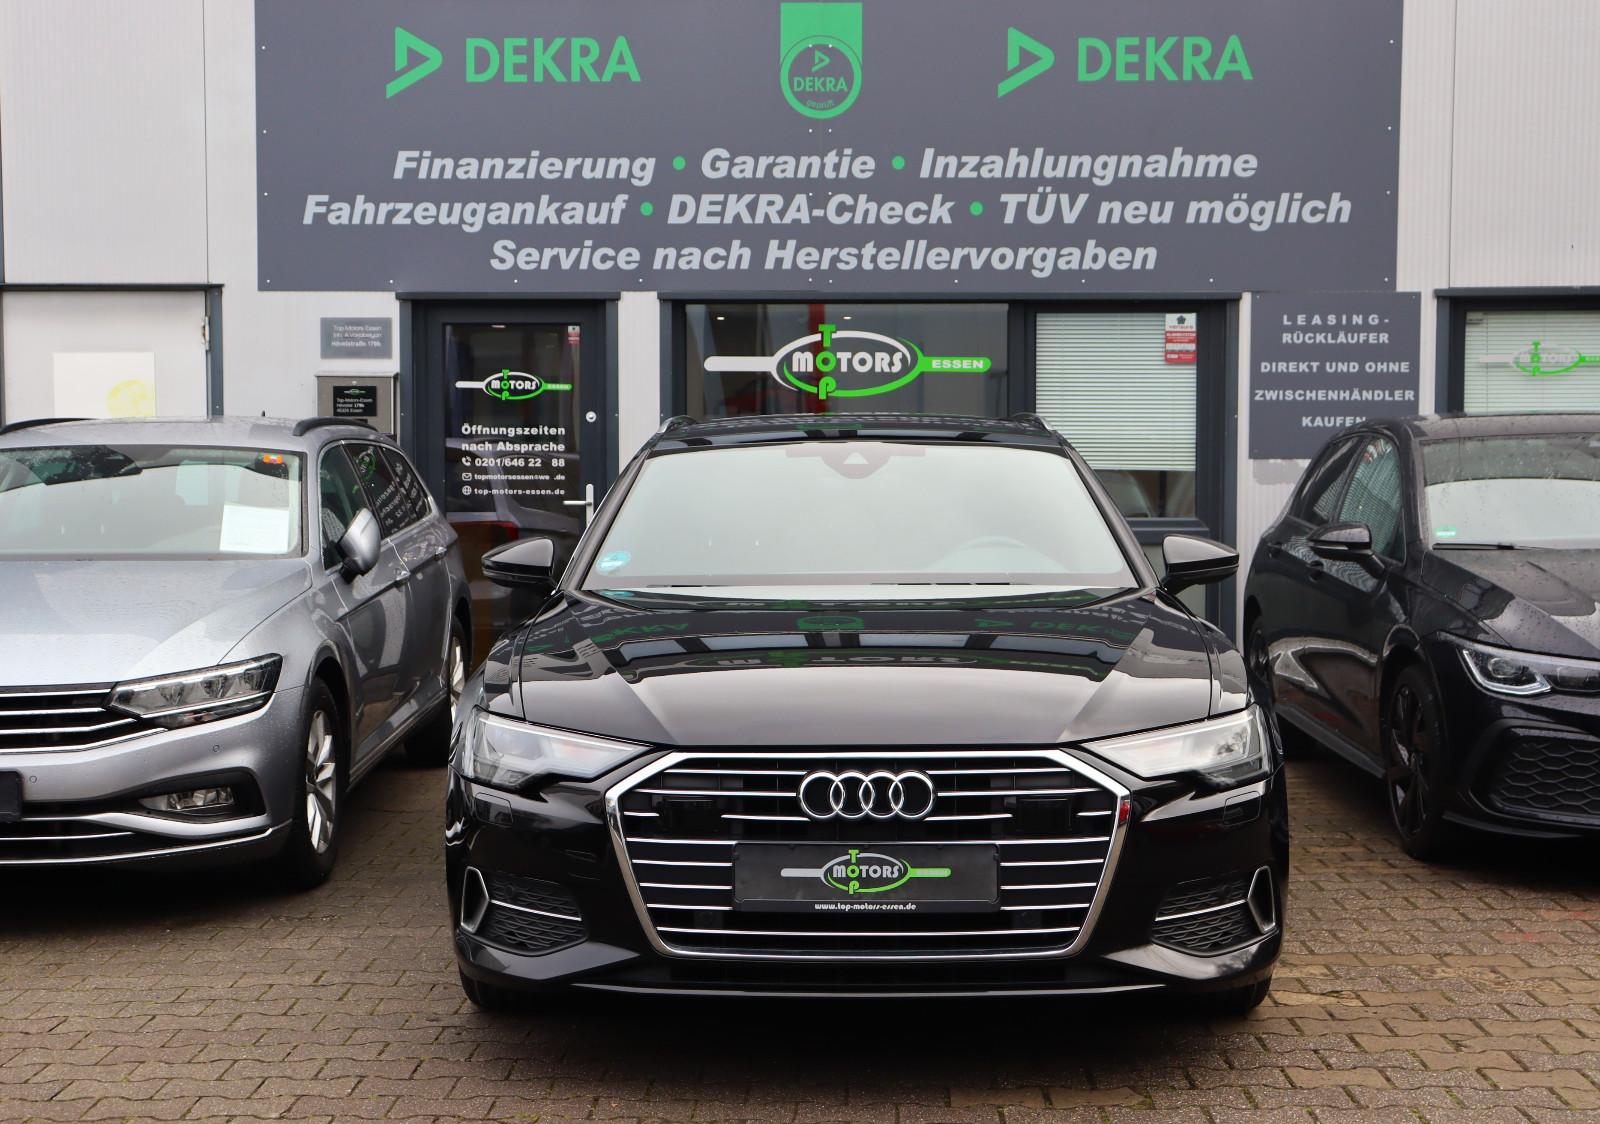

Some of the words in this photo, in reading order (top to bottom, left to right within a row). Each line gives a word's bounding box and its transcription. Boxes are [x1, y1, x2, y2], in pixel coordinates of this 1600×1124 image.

[466, 36, 641, 83] DEKRA
[1078, 35, 1253, 82] DEKRA
[793, 76, 848, 92] DEKRA
[393, 150, 656, 187] Finanzierung
[701, 148, 876, 179] Garantie
[919, 147, 1258, 186] Inzahlungnahme
[302, 193, 627, 233] Fahrzeugankauf
[667, 193, 954, 225] DEKRA-Check
[1000, 187, 1089, 224] TÜV
[1097, 199, 1174, 224] neu
[1185, 192, 1352, 232] möglich
[489, 239, 641, 271] Service
[652, 239, 752, 270] nach
[764, 239, 1158, 279] Herstellervorgaben
[1282, 314, 1390, 326] LEASING-
[1282, 331, 1390, 345] RÜCKLÄUFER
[792, 351, 903, 373] MOTORS
[931, 359, 984, 369] ESSEN
[1260, 361, 1320, 373] DIREKT
[1325, 361, 1360, 373] UND
[1364, 361, 1410, 373] OHNE
[490, 380, 538, 390] MOTORS
[1254, 388, 1415, 401] ZWISCHENHÄNDLER
[461, 422, 566, 437] Öffnungszeiten
[461, 441, 493, 451] nach
[497, 441, 565, 453] Absprache
[474, 457, 525, 467] 0201/646
[527, 457, 542, 467] 22
[551, 457, 565, 467] 88
[474, 487, 565, 496] top-motors-essen.de
[832, 864, 900, 878] MOTORS
[814, 901, 917, 912] www.top-motors-essen.de
